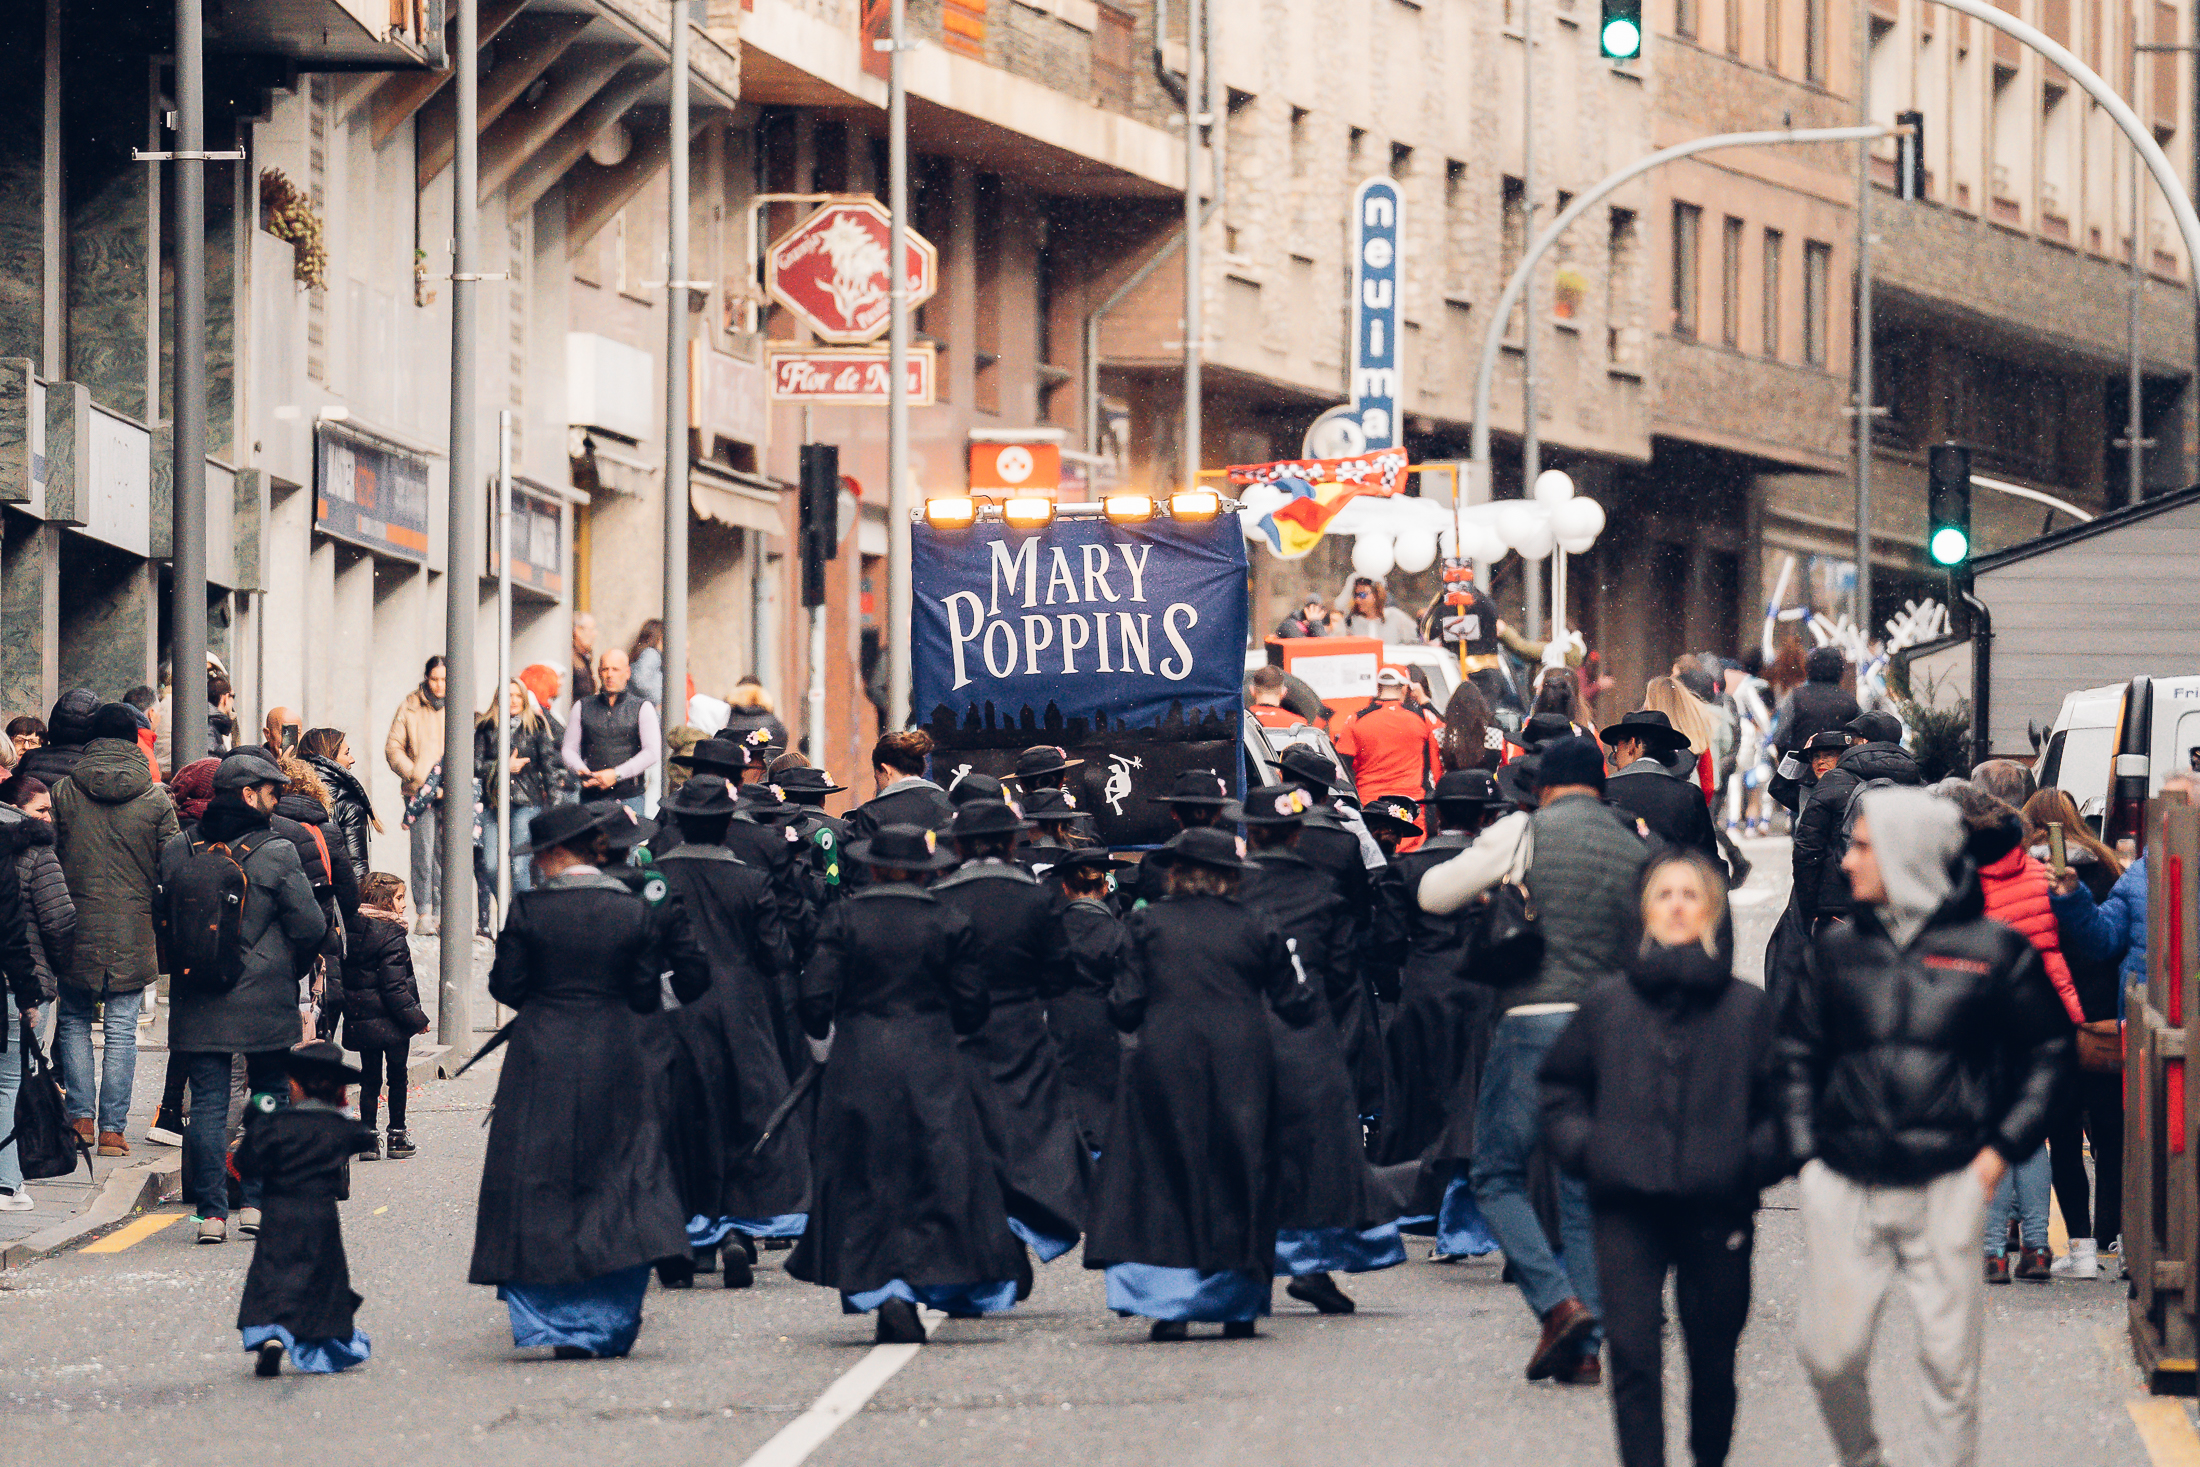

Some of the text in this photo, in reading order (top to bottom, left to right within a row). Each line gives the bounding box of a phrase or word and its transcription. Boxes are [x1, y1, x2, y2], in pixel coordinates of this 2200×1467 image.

[1357, 196, 1395, 439] neuima
[778, 361, 832, 393] Flor
[833, 365, 861, 392] de
[986, 536, 1154, 617] MARY
[940, 590, 1199, 691] POPPINS
